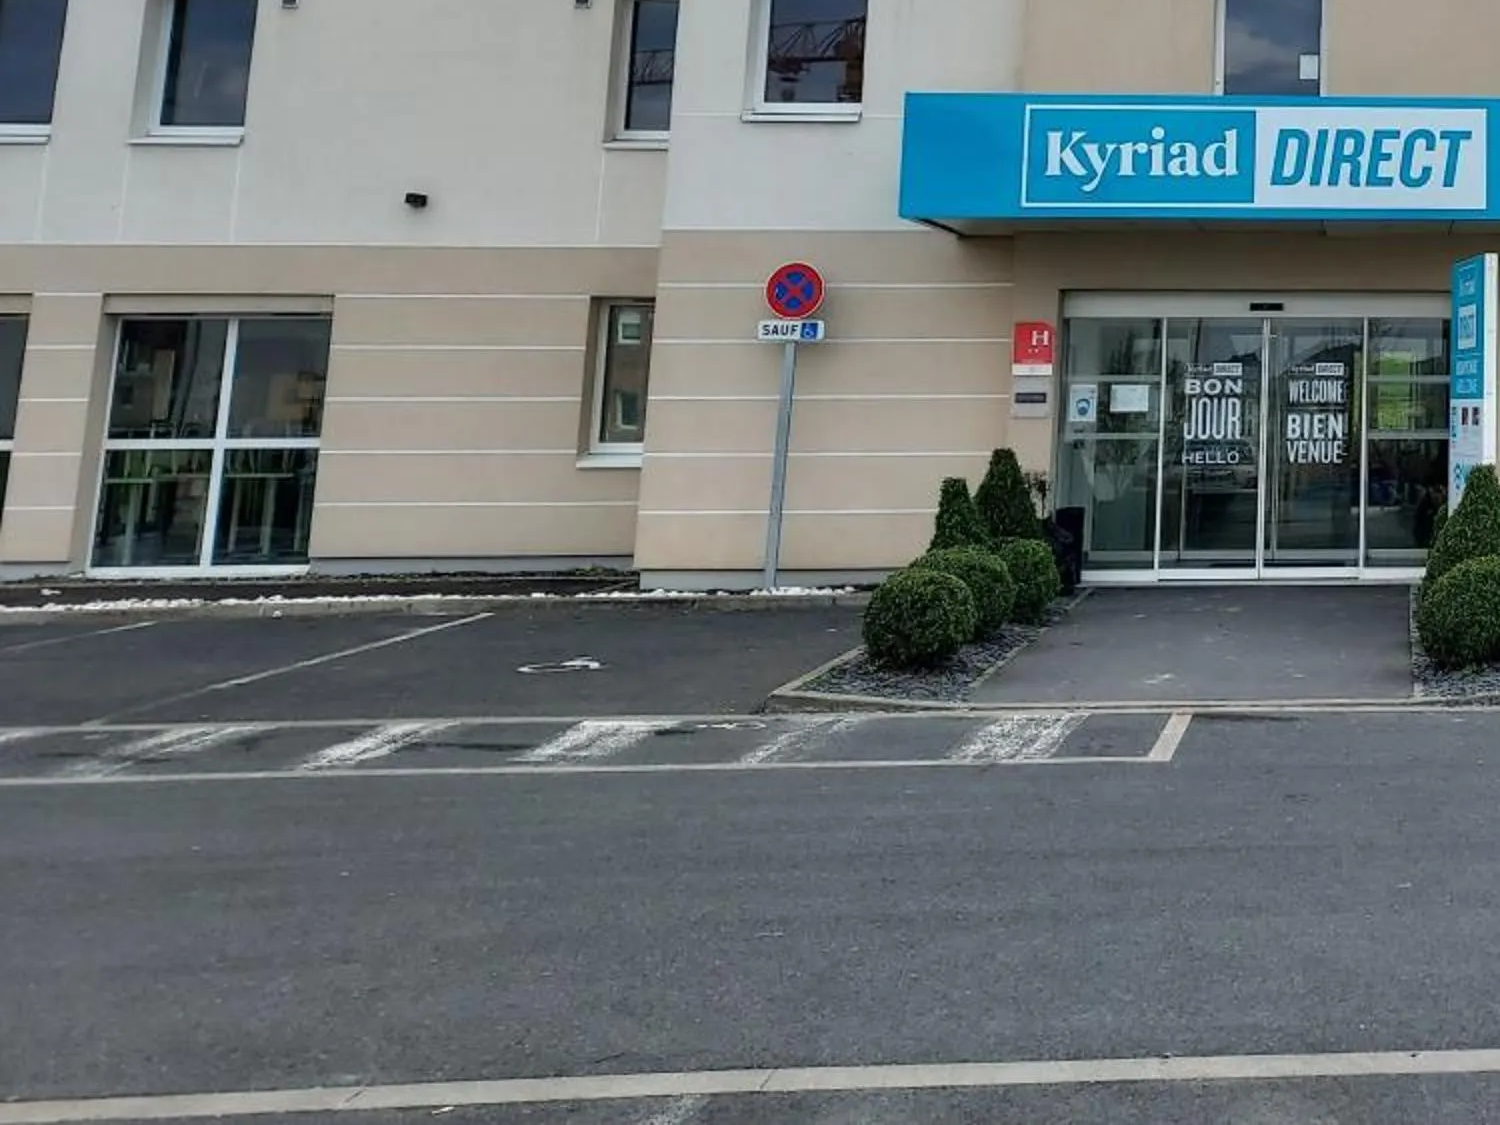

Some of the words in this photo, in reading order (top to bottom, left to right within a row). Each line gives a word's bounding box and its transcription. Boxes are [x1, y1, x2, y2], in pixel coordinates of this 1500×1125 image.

[1045, 126, 1239, 192] Kyriad
[1270, 128, 1472, 189] DIRECT
[762, 324, 799, 336] SAUF
[1031, 330, 1049, 346] H
[1184, 378, 1243, 395] BON
[1288, 380, 1344, 403] WELCOME
[1183, 397, 1241, 440] JOUR
[1286, 413, 1343, 439] BIEN
[1181, 450, 1240, 464] HELLO
[1286, 440, 1343, 464] VENUE
